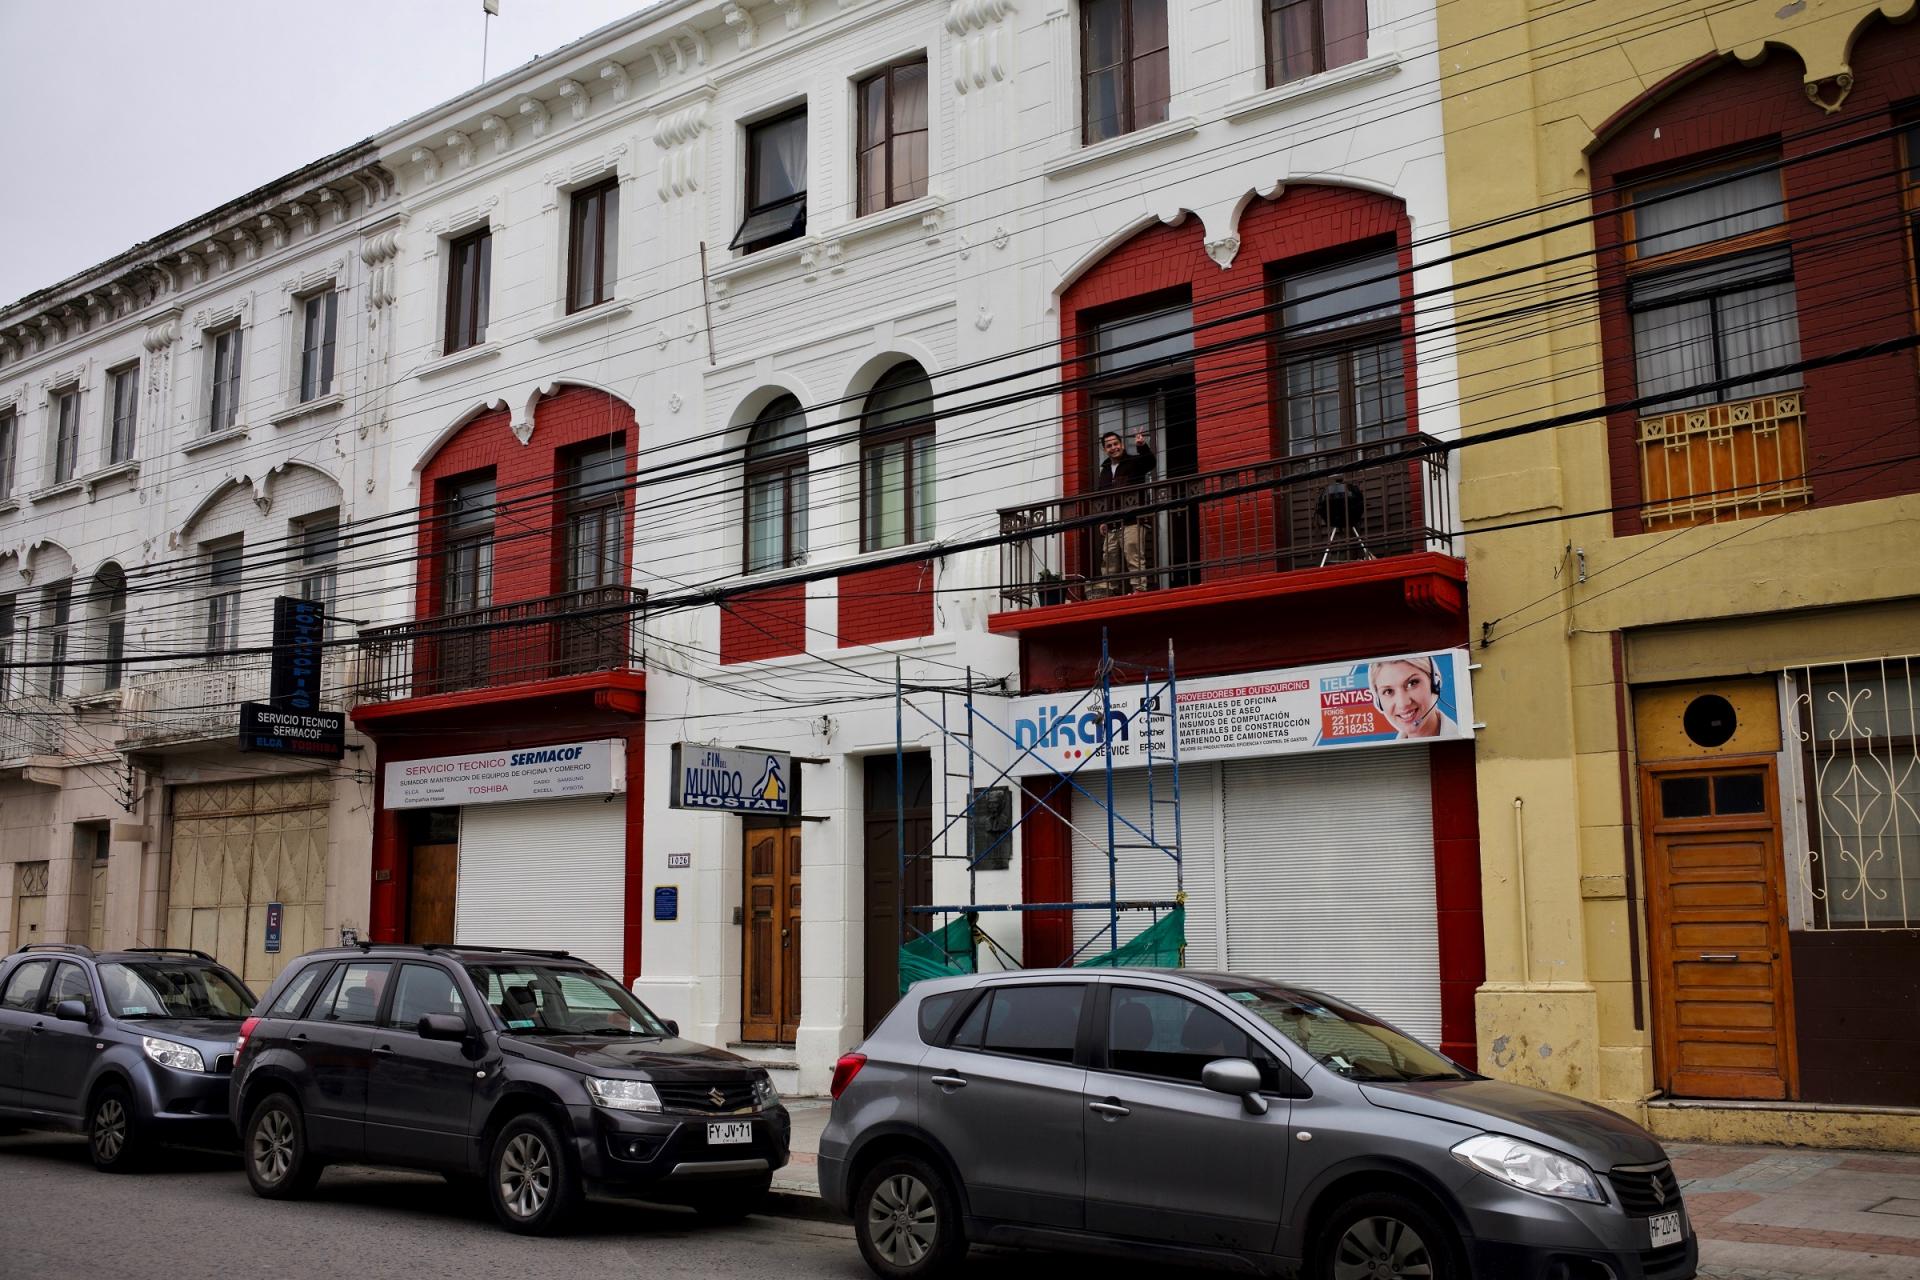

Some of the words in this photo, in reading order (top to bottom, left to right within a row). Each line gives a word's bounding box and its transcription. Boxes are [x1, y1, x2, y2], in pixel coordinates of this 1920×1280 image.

[1176, 688, 1234, 703] PROVEEDORES
[1236, 688, 1247, 696] DE
[1248, 680, 1308, 695] OUTSOURCING
[1324, 690, 1373, 706] VENTAS
[1179, 700, 1228, 712] MATERIALES
[1244, 696, 1277, 706] OFICINA
[258, 712, 299, 726] SERVICIO
[301, 716, 338, 730] TECNICO
[1180, 708, 1224, 720] ARTÍCULOS
[1240, 706, 1261, 714] ASEO
[1180, 716, 1215, 728] INSUMOS
[1218, 717, 1229, 725] DE
[1230, 710, 1290, 724] COMPUTACIÓN
[1332, 712, 1374, 726] 2217713
[273, 725, 322, 739] SERMACOF
[1179, 726, 1229, 737] MATERIALES
[1244, 718, 1310, 731] CONSTRUCCIÓN
[1332, 722, 1374, 736] 2218253
[256, 737, 284, 748] ELCA
[1180, 735, 1220, 745] ARRIENDO
[1236, 729, 1289, 740] CAMIONETAS
[1096, 744, 1130, 758] SEVICE
[406, 764, 454, 776] SERVICIO
[457, 758, 506, 771] TECNICO
[510, 746, 582, 766] SERMACOF
[706, 752, 720, 768] FIN
[400, 778, 428, 787] SUMADOR
[430, 775, 470, 784] MANTENCION
[481, 772, 510, 780] EQUIPOS
[554, 763, 592, 772] COMERCIO
[686, 767, 742, 797] MUNDO
[468, 784, 509, 794] TOSHIBA
[686, 795, 784, 810] HOSTAL
[671, 856, 688, 865] 1026
